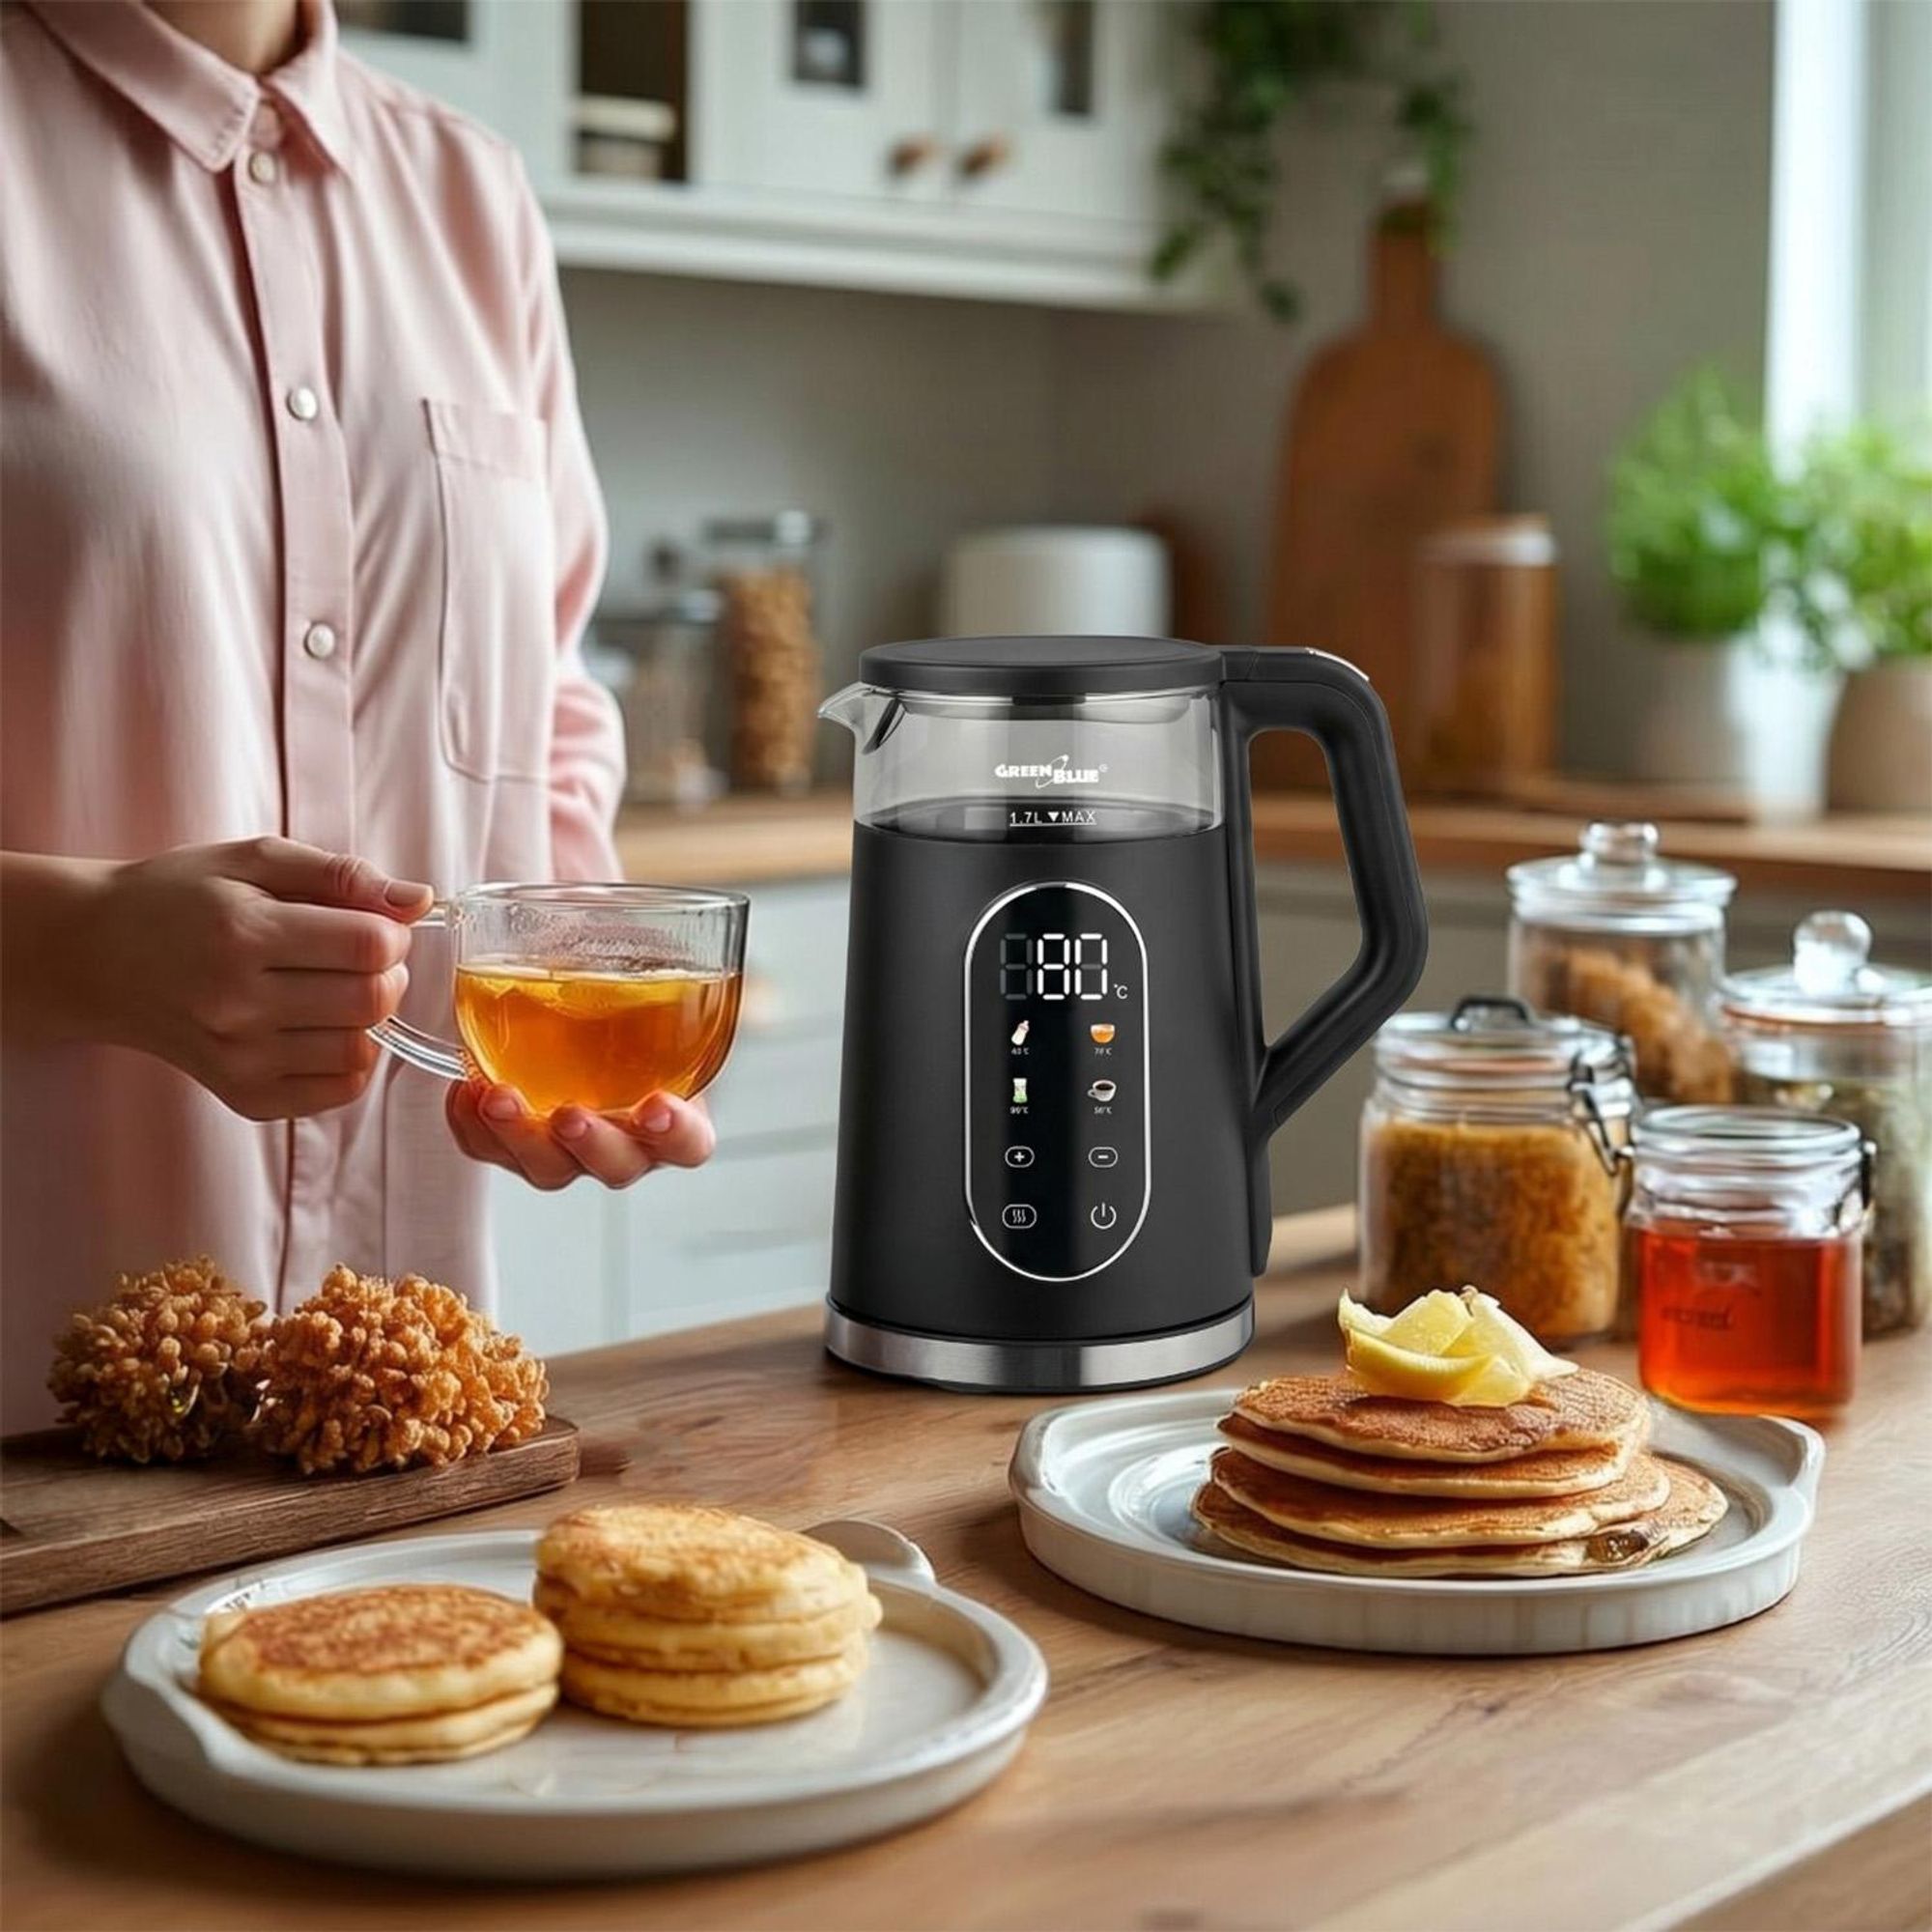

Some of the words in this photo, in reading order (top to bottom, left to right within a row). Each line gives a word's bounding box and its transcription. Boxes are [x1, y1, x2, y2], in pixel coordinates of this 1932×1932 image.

[1009, 811, 1042, 825] 1.7L
[1063, 810, 1096, 823] MAX
[1037, 933, 1108, 1000] 80
